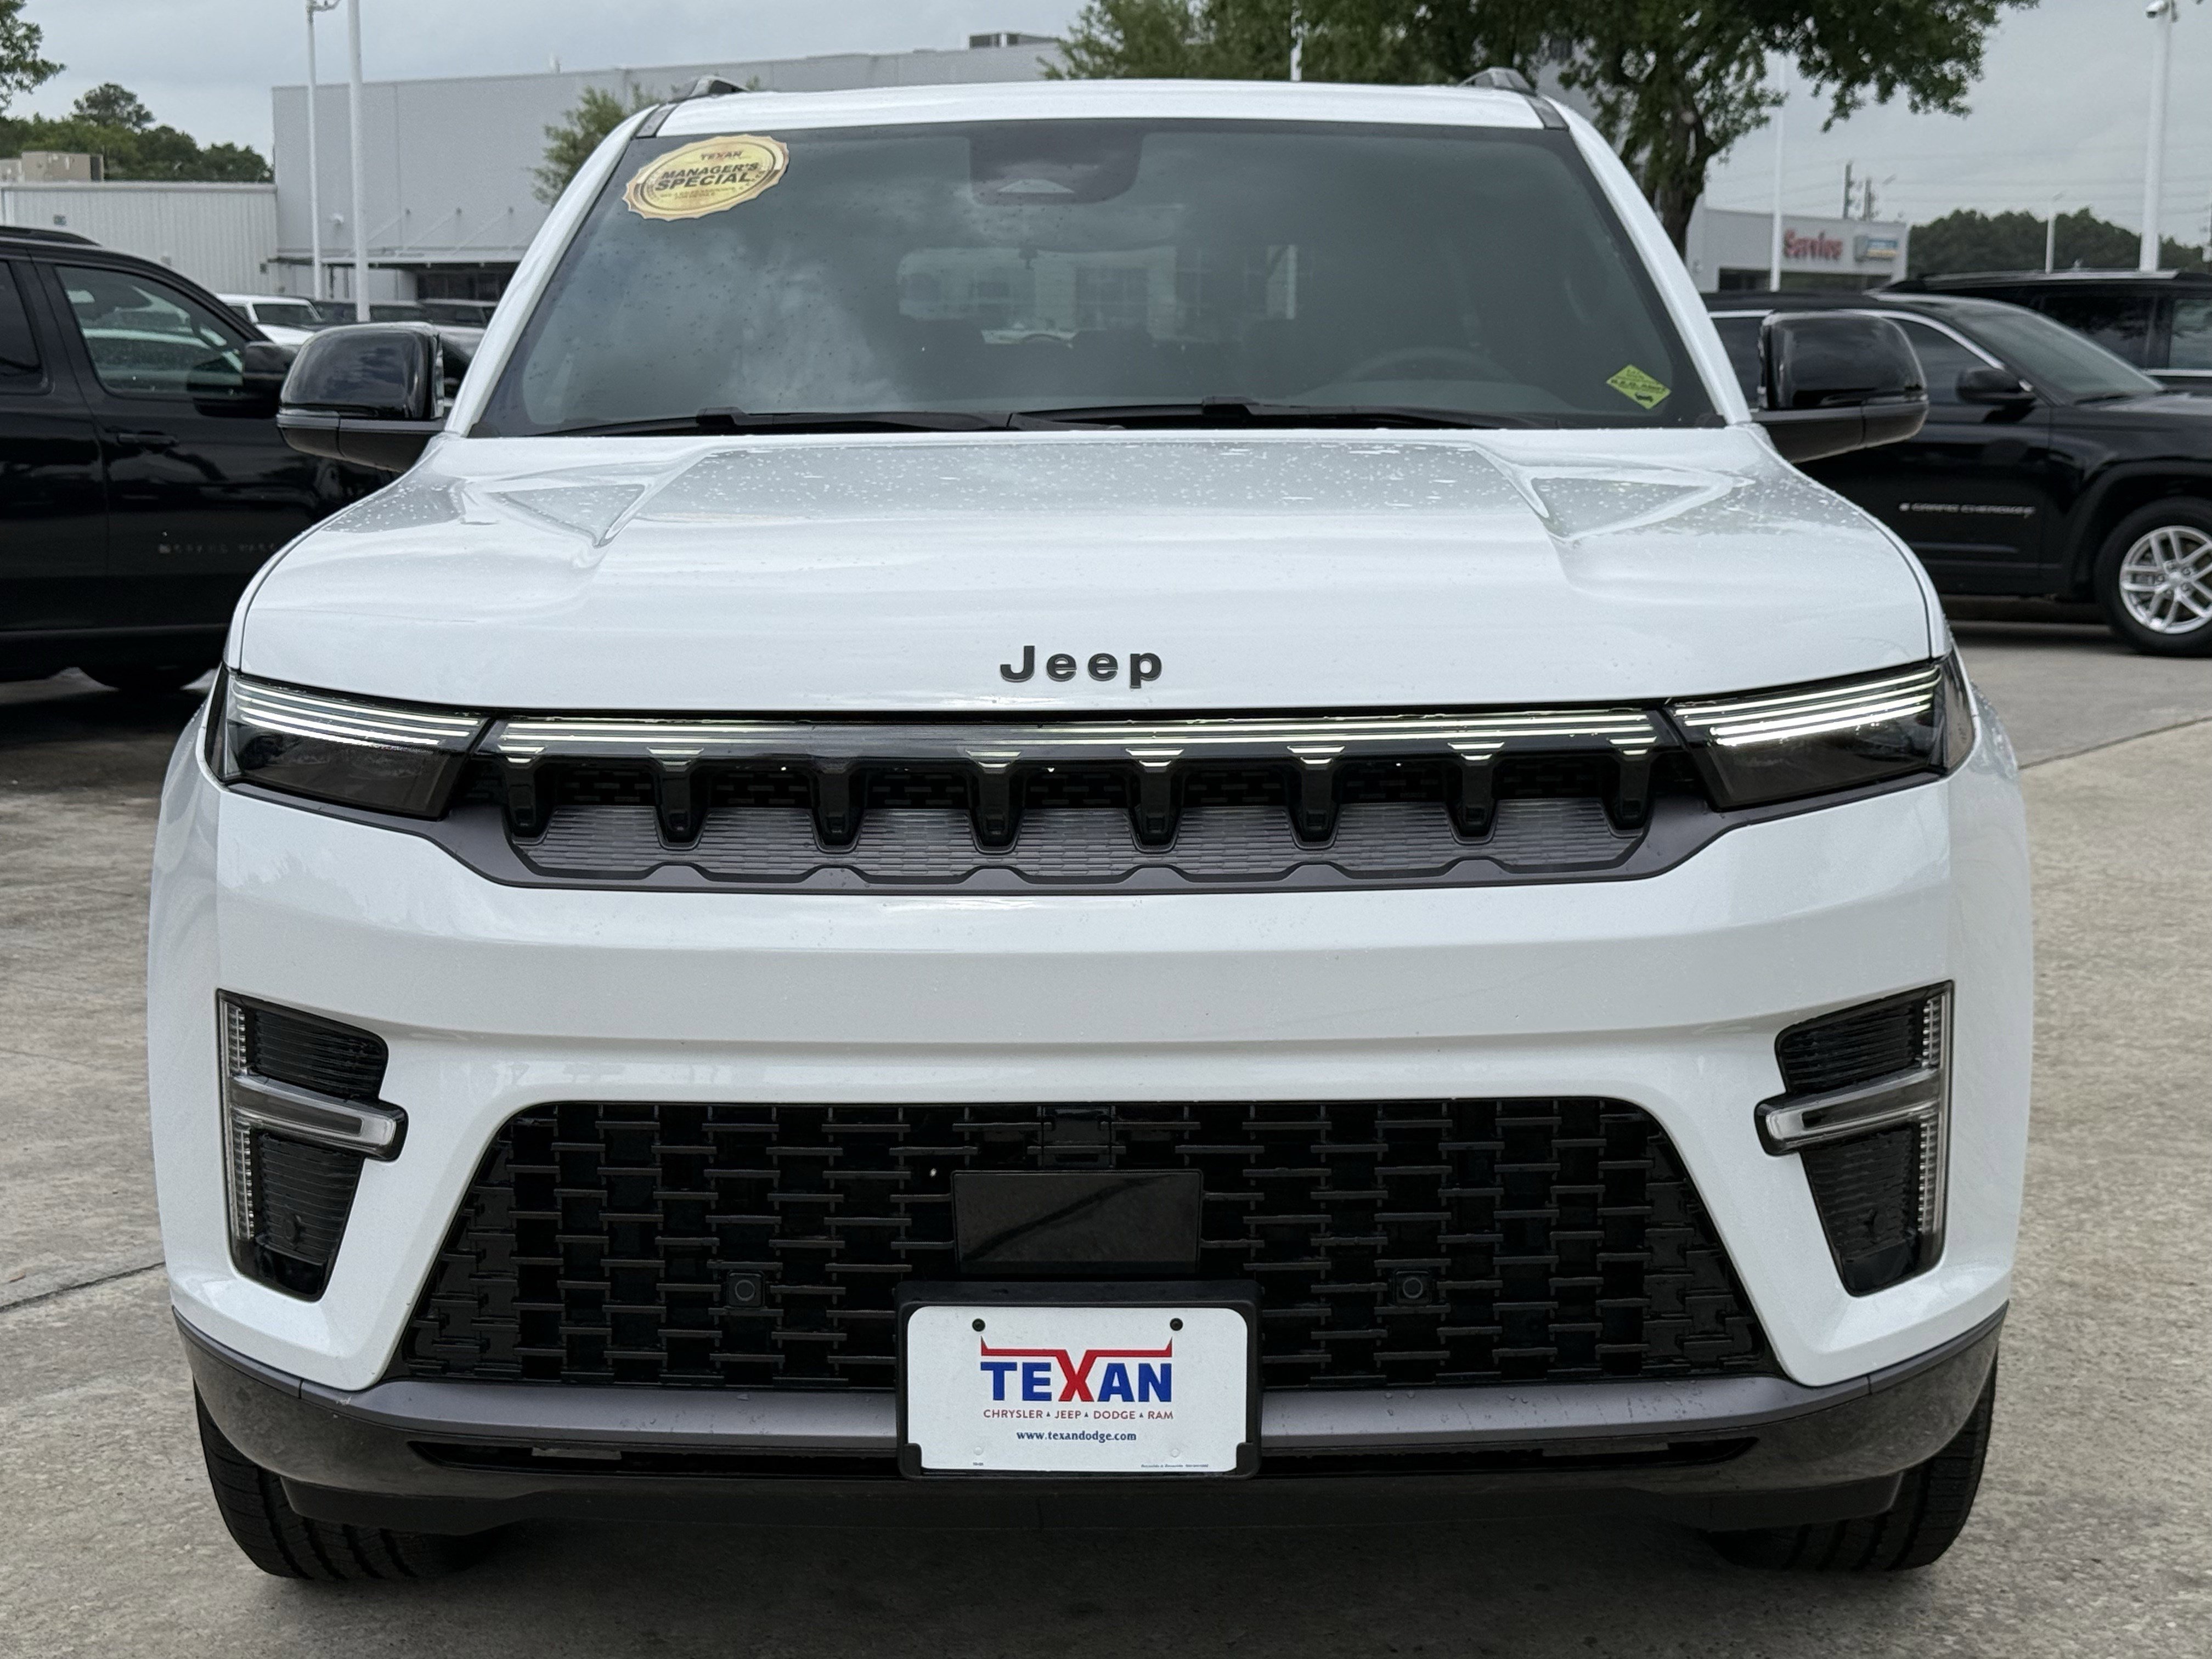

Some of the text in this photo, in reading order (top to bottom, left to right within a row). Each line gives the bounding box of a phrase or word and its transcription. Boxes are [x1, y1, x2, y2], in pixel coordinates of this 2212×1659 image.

[700, 151, 742, 161] TEXAN
[661, 162, 759, 179] MANAGER'S
[655, 172, 753, 191] SPECIAL
[1000, 645, 1163, 689] Jeep
[980, 1347, 1172, 1402] TEXAN
[983, 1409, 1174, 1420] CHRYSLER JEEP DODGE RAM
[1016, 1430, 1137, 1443] www.texandodge.com
